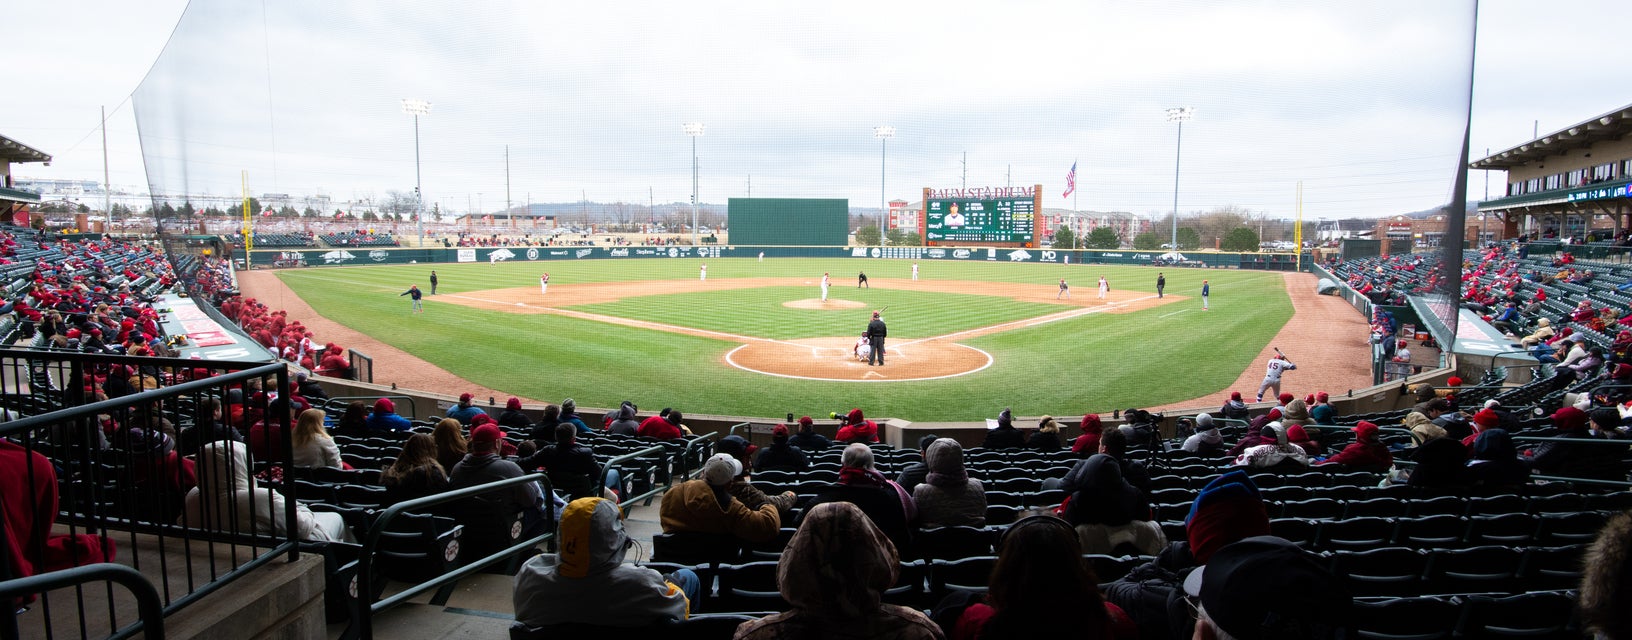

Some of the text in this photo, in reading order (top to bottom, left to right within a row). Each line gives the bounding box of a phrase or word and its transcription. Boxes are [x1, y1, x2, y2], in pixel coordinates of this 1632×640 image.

[928, 186, 1032, 199] BAUM STADIUM
[1042, 250, 1057, 259] MD
